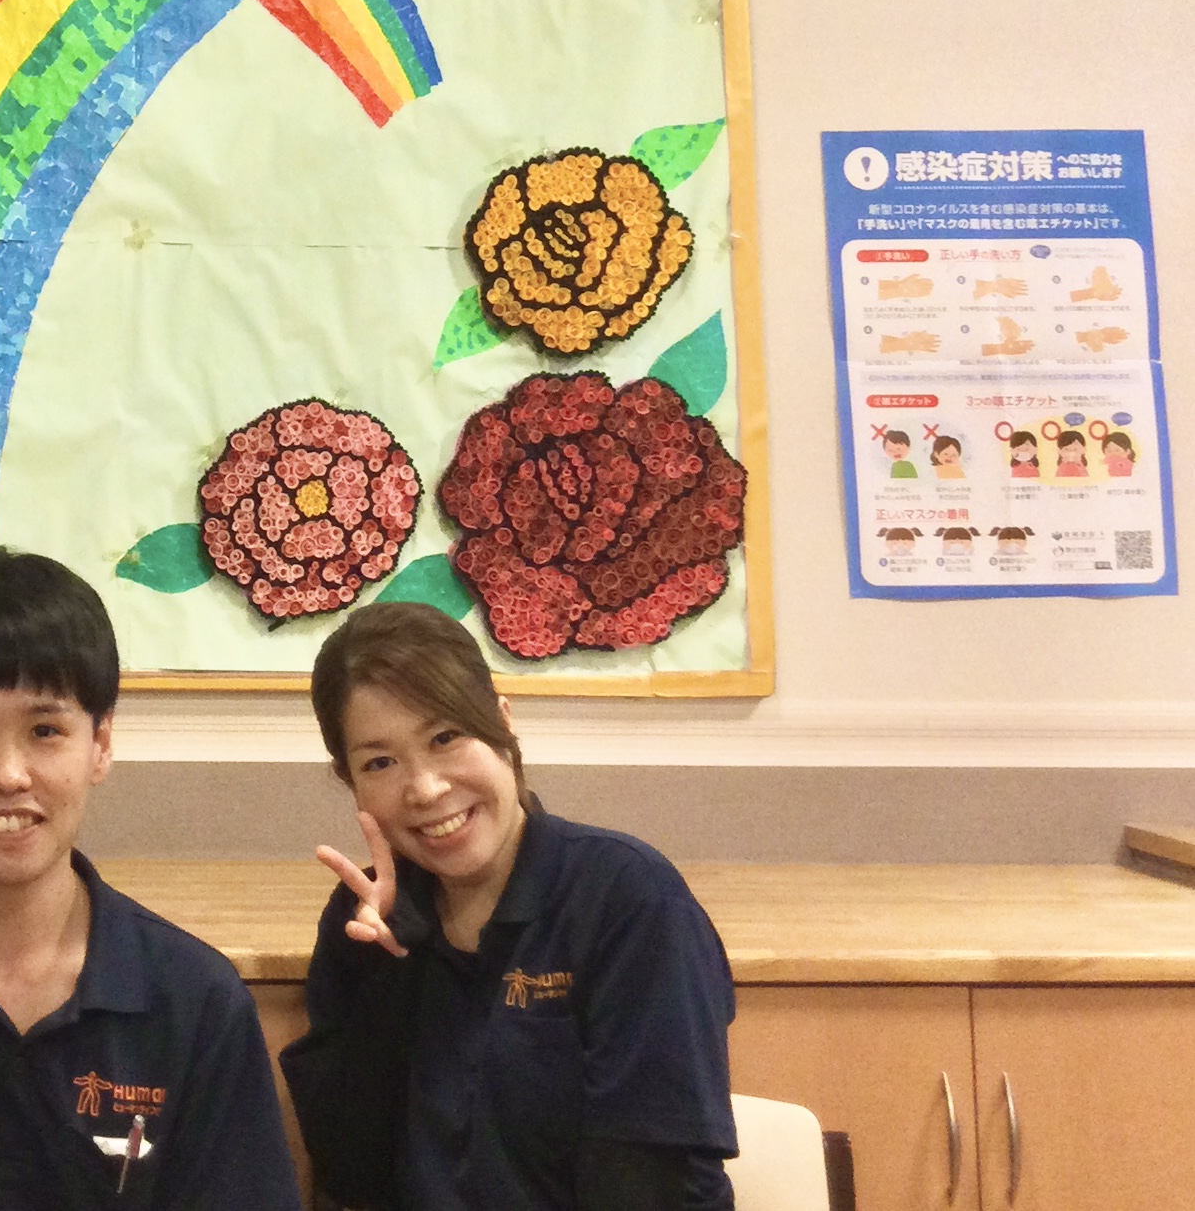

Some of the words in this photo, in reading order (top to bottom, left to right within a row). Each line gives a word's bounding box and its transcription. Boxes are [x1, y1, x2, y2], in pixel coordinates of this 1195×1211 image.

[895, 150, 1053, 182] 感染症対策
[113, 1085, 166, 1104] Huma
